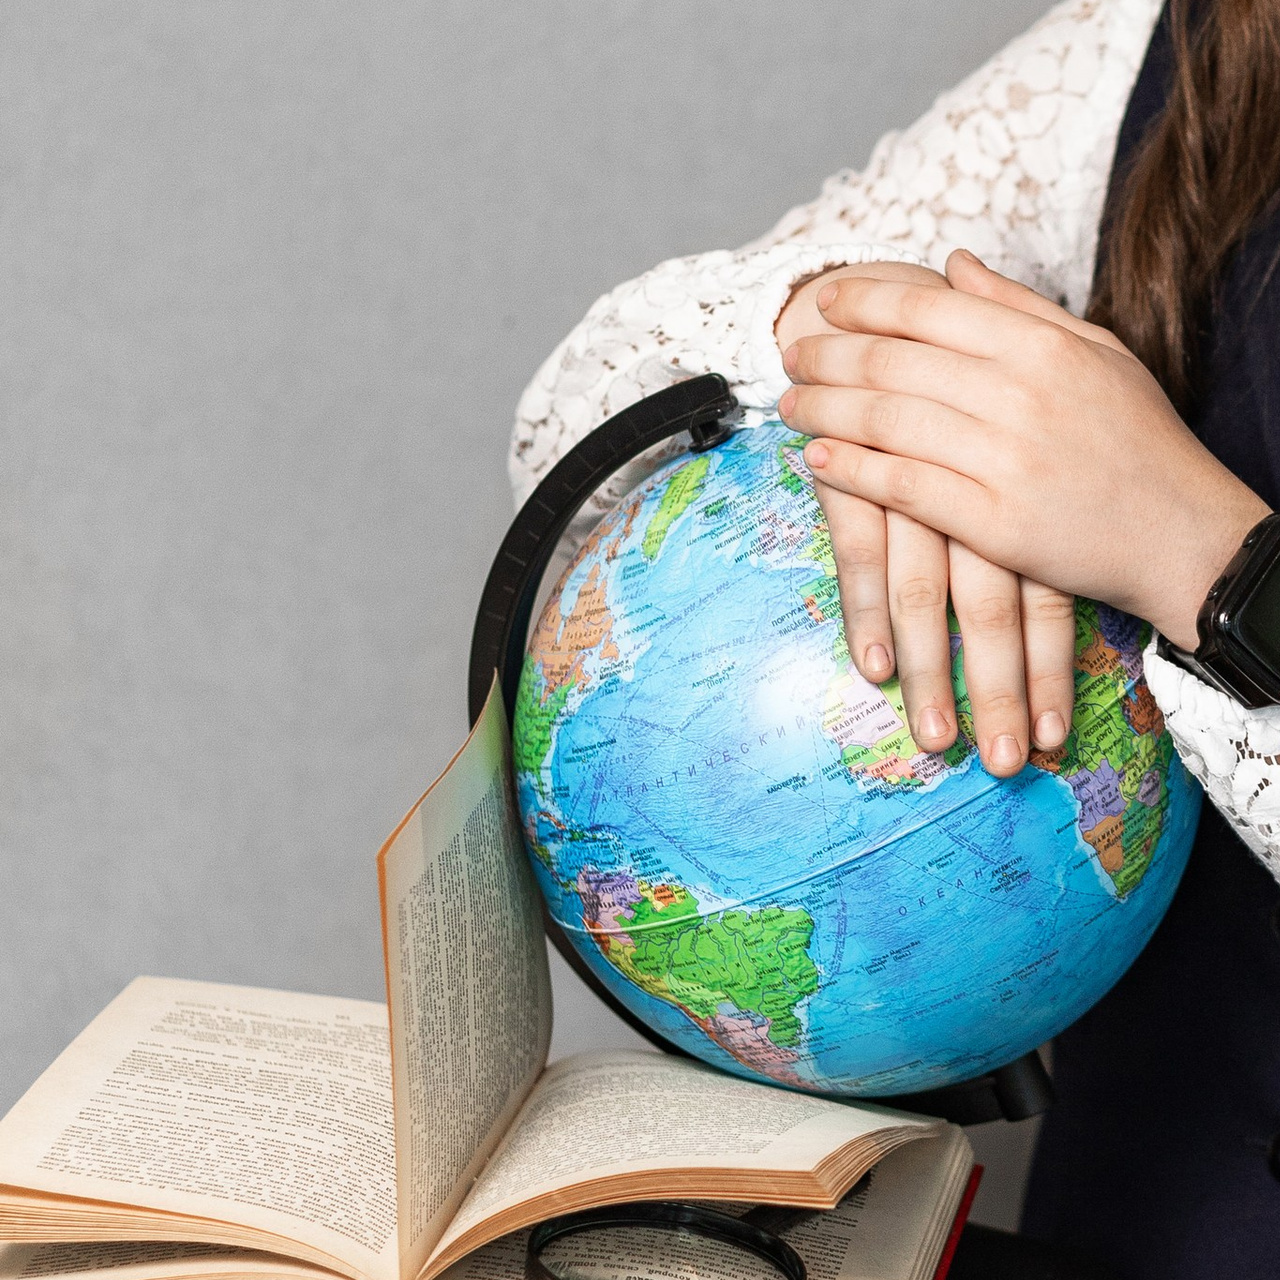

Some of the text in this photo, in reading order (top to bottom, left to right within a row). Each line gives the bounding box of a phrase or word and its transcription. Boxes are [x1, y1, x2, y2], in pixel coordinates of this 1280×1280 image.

[772, 599, 816, 627] ПОРТУГАЛИЯ
[779, 614, 810, 637] ЛИССАБОН
[832, 699, 887, 733] МАВРИТАНИЯ
[844, 748, 869, 765] СЕНЕГАЛ
[603, 1263, 639, 1271] сильно
